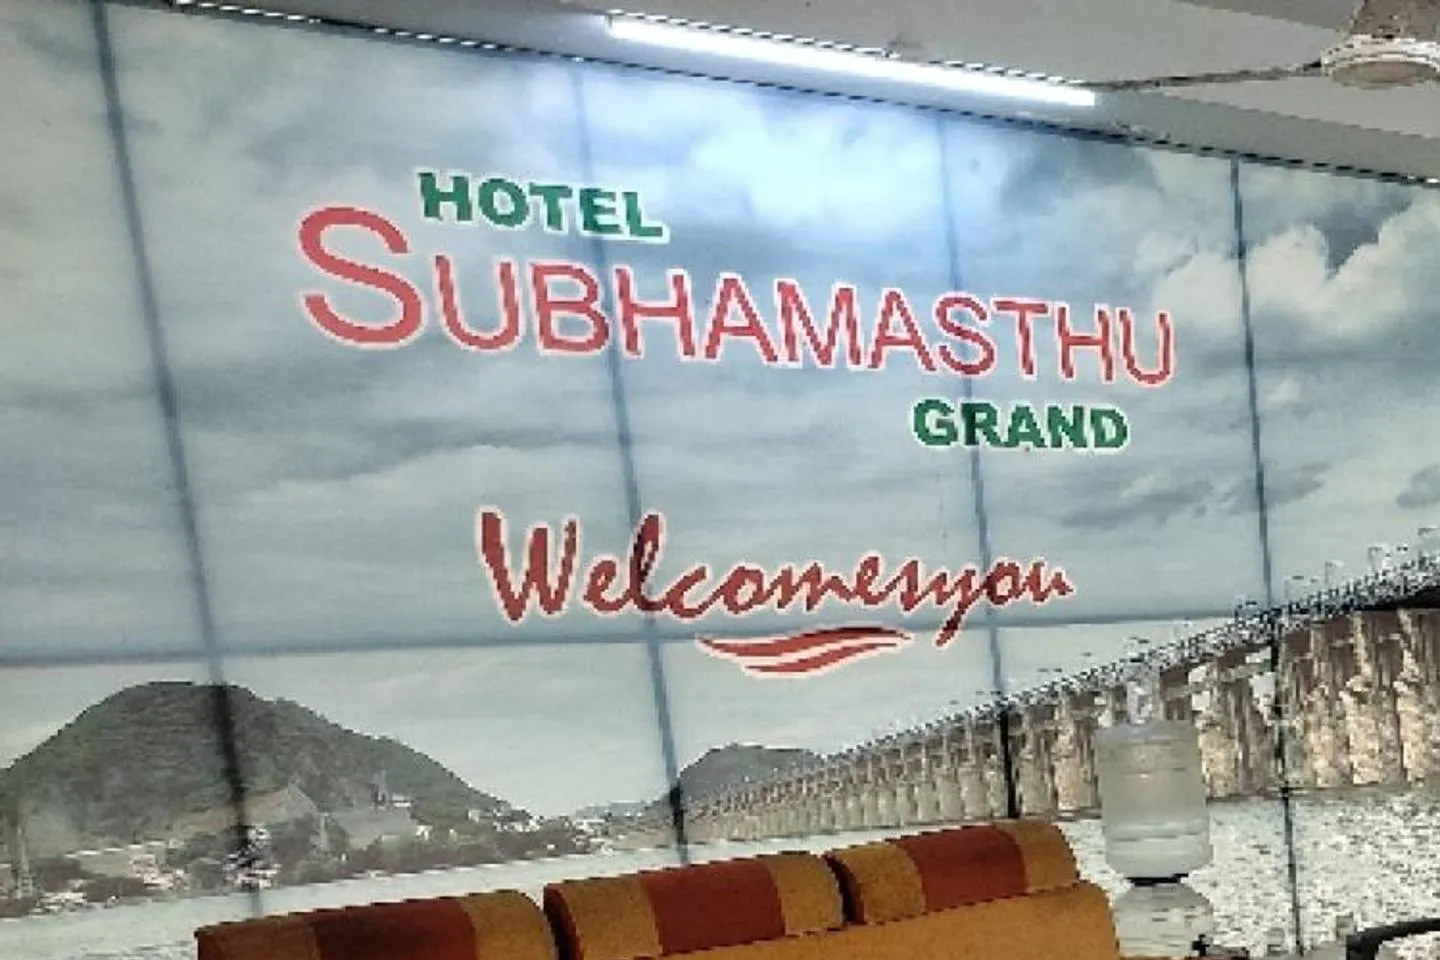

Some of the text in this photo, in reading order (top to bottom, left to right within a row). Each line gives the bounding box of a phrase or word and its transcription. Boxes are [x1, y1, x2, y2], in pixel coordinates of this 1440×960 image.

[419, 171, 664, 238] HOTEL
[298, 206, 1174, 386] SUBHAMASTHU
[913, 398, 1129, 449] GRAND
